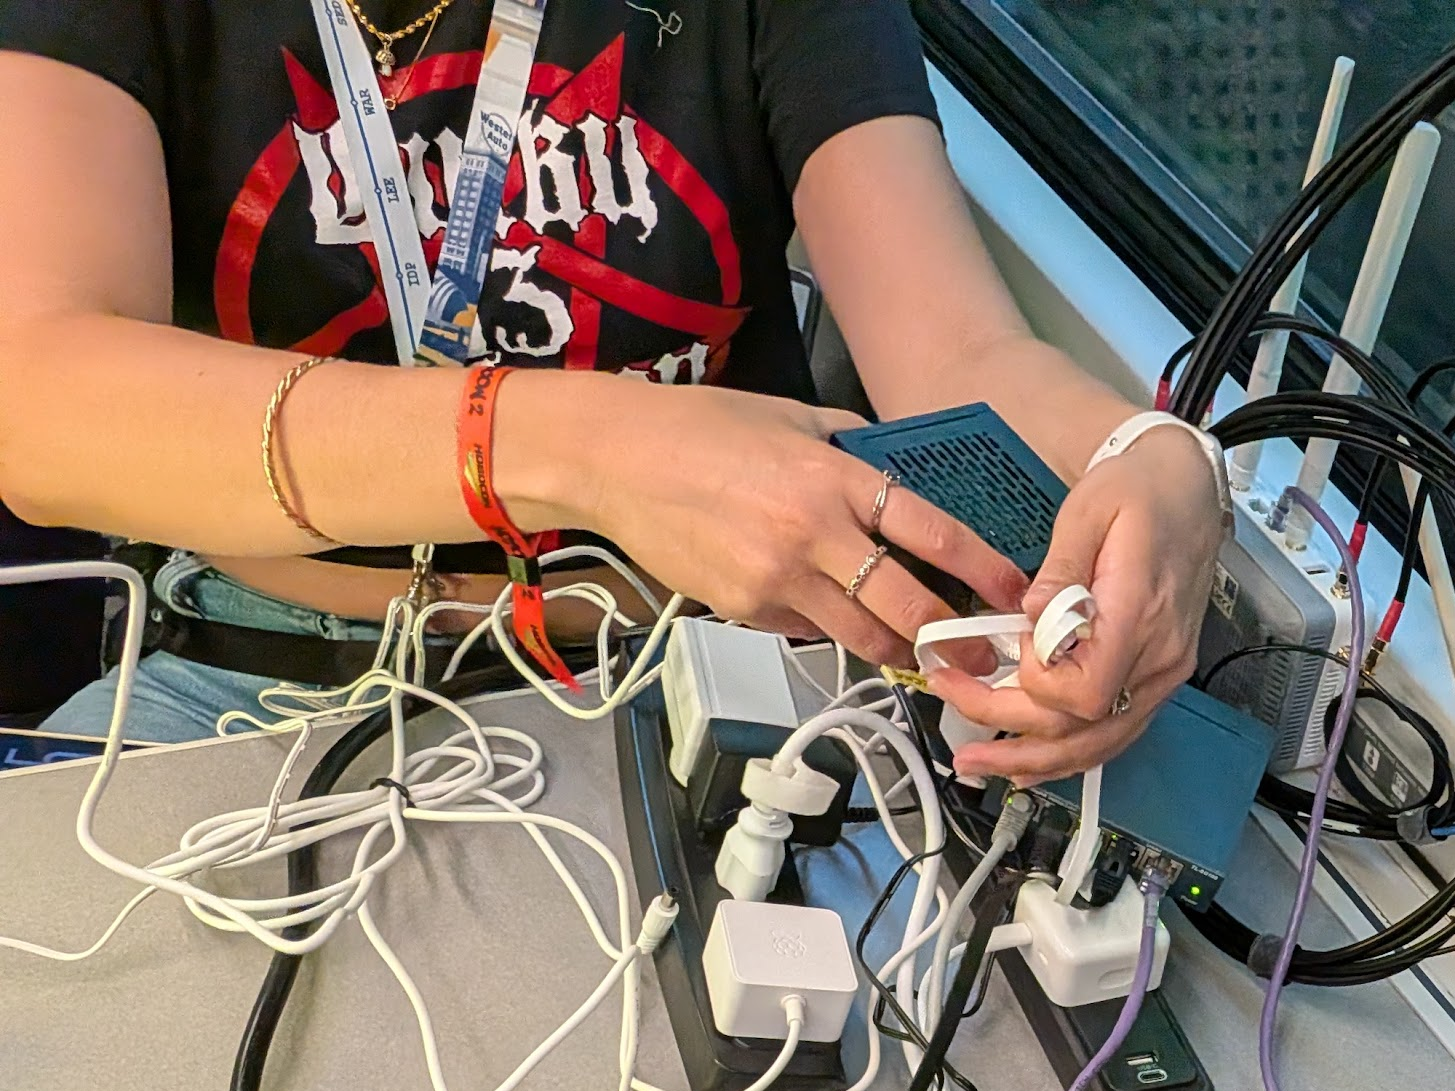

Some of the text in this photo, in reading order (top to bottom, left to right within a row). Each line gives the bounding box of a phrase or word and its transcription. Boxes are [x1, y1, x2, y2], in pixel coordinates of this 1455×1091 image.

[332, 0, 348, 26] SED
[359, 88, 376, 116] WAR
[487, 131, 508, 151] Auto
[383, 177, 400, 204] LEE
[405, 262, 420, 287] IDP
